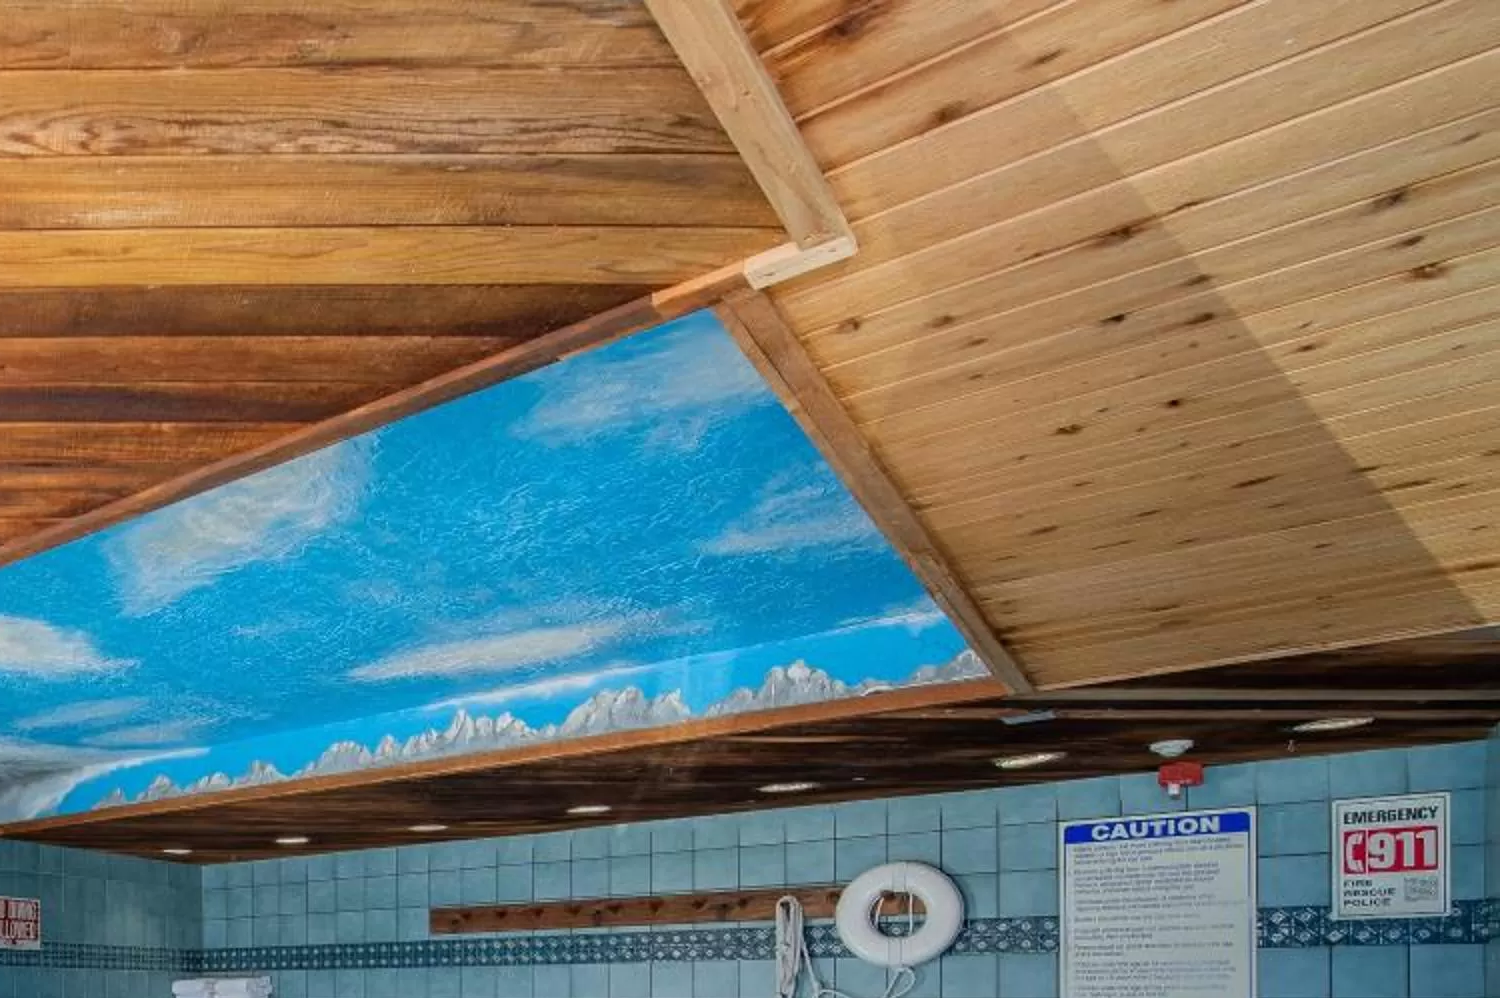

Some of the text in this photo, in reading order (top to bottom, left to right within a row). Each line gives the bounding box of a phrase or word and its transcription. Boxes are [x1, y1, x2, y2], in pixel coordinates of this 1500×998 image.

[1343, 806, 1439, 825] EMERGENCY
[1091, 815, 1221, 841] CAUTION
[1368, 830, 1437, 869] 911
[1343, 898, 1392, 907] POLICE
